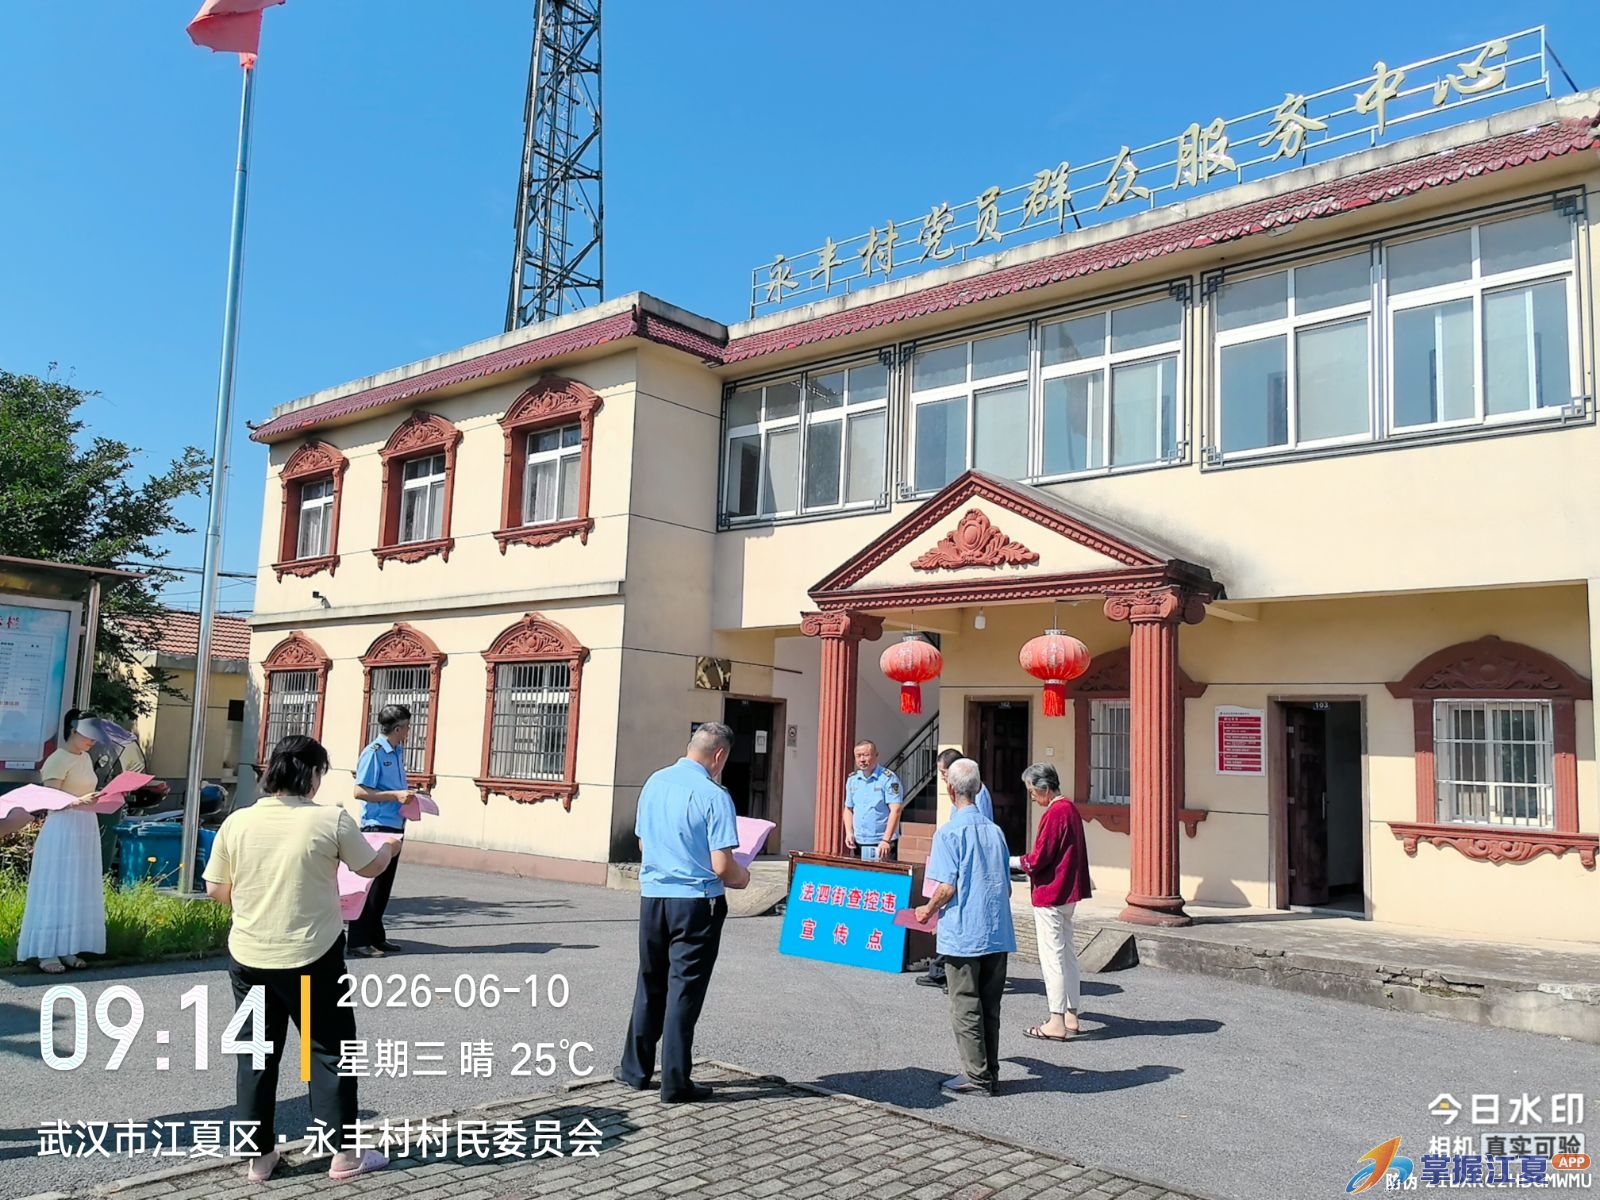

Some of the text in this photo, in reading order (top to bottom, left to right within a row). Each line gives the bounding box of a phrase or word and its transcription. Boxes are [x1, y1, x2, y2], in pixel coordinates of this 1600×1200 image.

[764, 40, 1509, 305] 永丰村党员群众服务中心
[799, 881, 898, 914] 法泗街查控违
[800, 917, 883, 951] 宣传点
